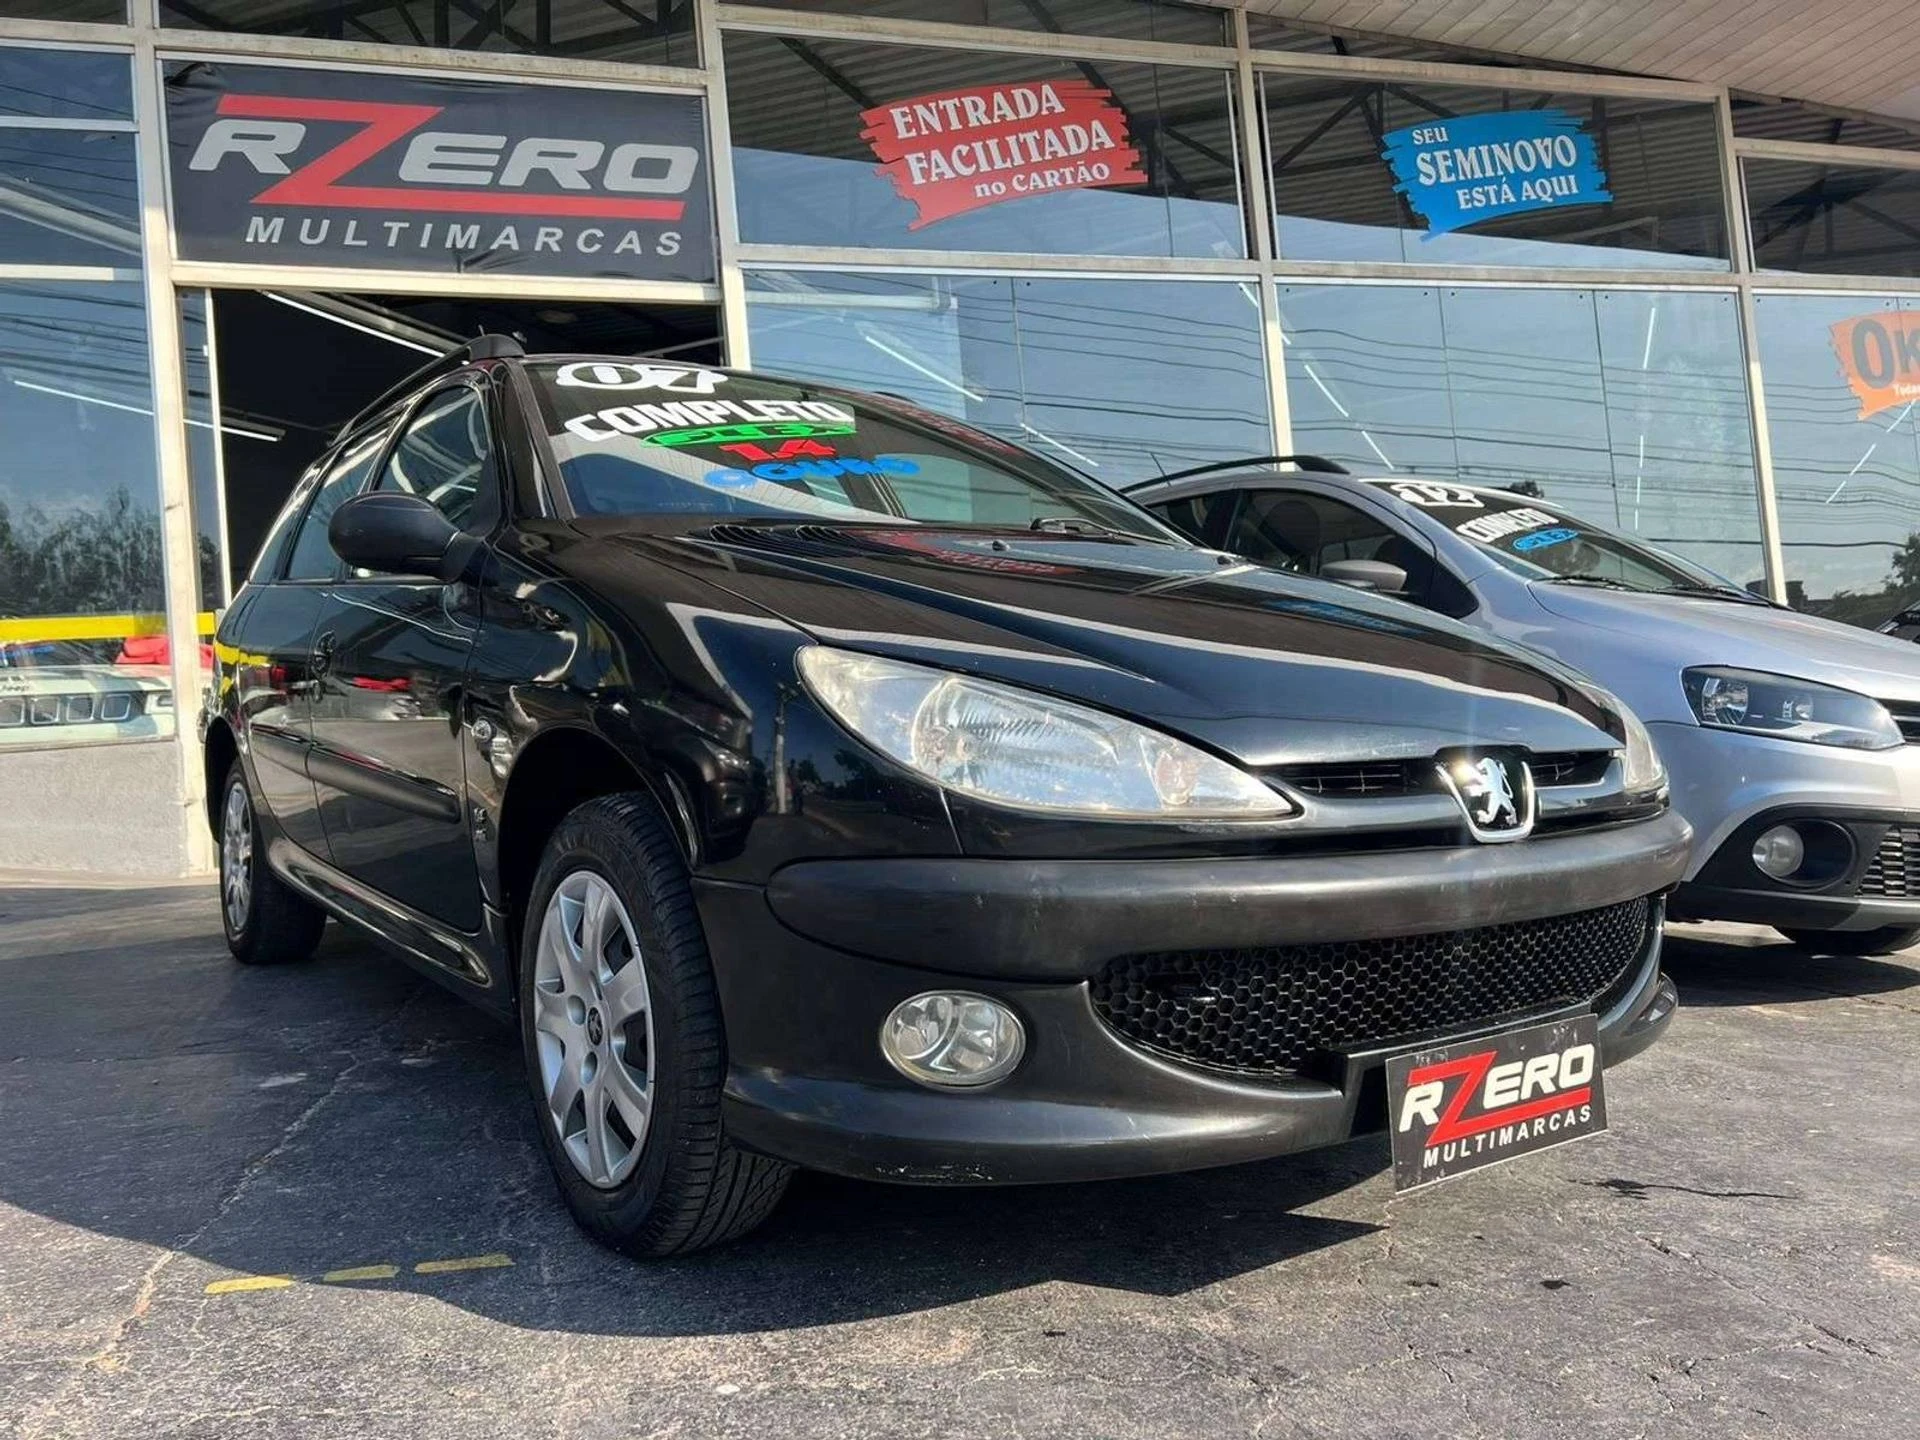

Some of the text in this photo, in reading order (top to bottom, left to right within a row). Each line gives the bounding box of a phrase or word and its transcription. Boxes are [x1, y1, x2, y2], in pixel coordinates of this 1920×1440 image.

[889, 84, 1065, 140] ENTRADA
[1412, 127, 1449, 145] SEU
[189, 94, 699, 220] RZERO
[904, 119, 1115, 185] FACILITADA
[1416, 135, 1577, 186] SEMINOVO
[974, 160, 1110, 198] no CARTÃO
[1456, 175, 1579, 210] ESTÁ AQUI
[245, 216, 682, 256] MULTIMARCAS
[564, 399, 853, 442] COMPLETO
[1399, 1043, 1595, 1147] RZERO
[1423, 1105, 1592, 1168] MULTIMARCAS
